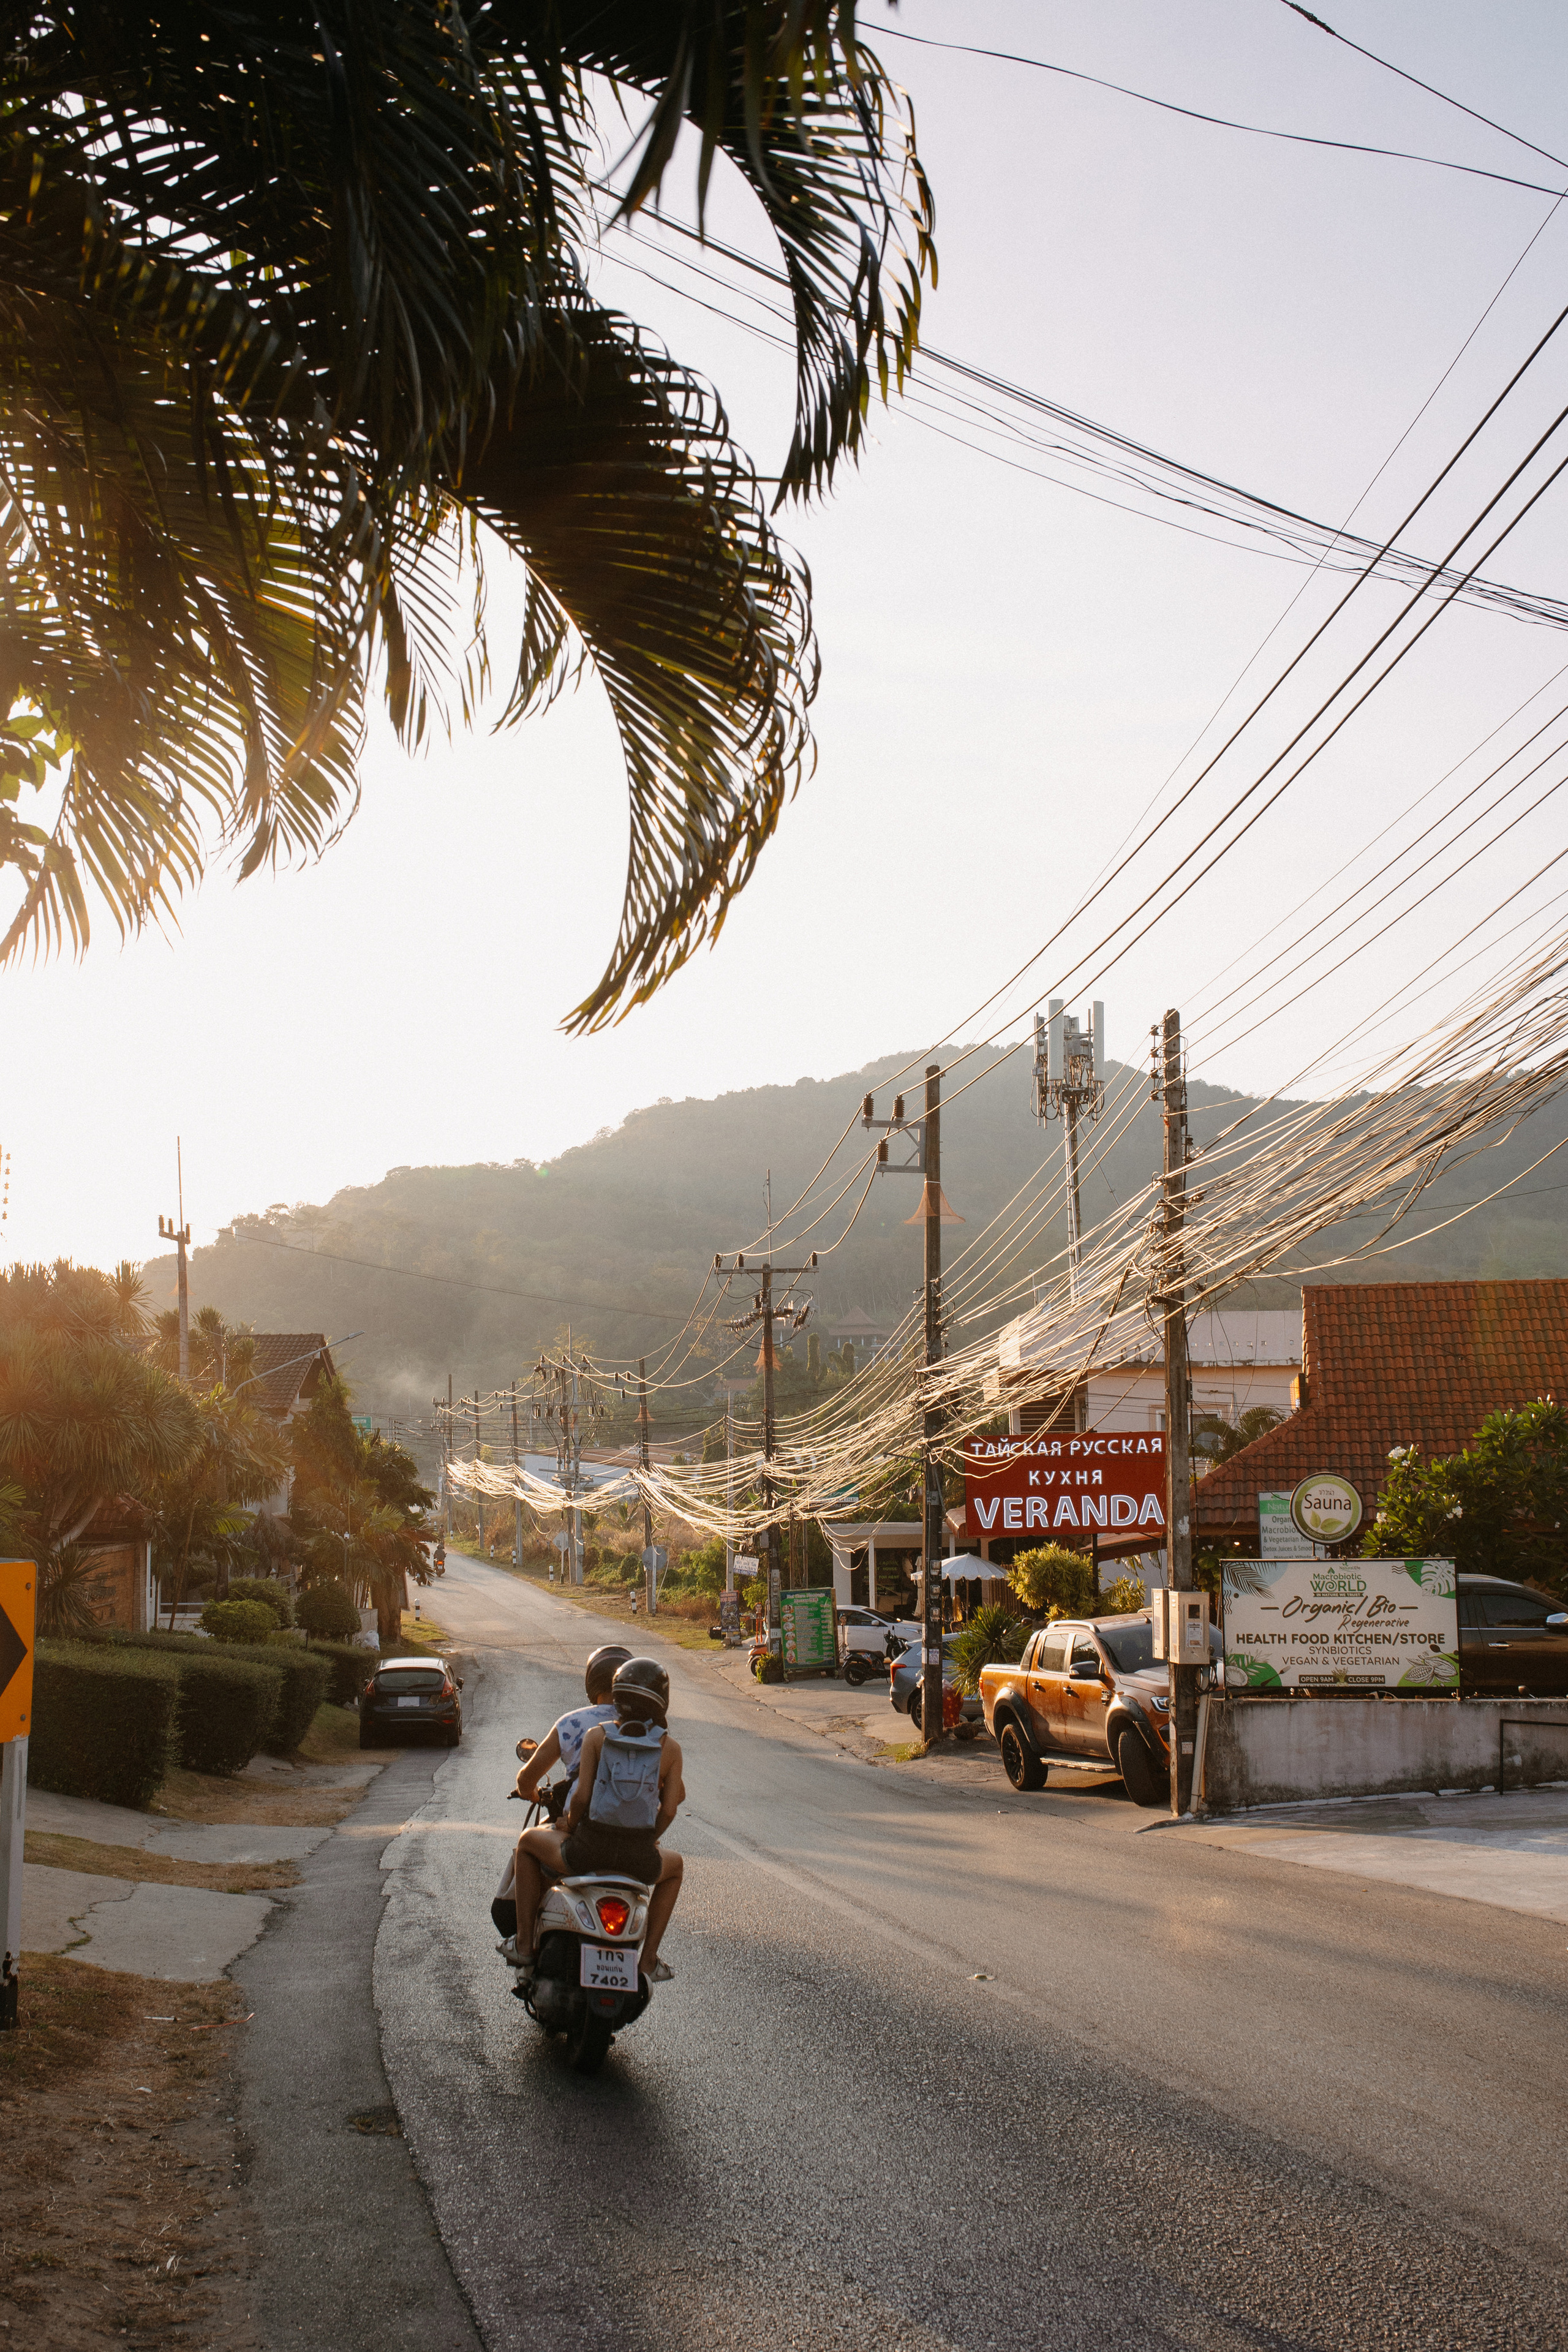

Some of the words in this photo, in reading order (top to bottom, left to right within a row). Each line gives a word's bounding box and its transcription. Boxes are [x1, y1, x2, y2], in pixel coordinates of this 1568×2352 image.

[971, 1438, 1061, 1457] ТАЙСКАЯ
[1070, 1438, 1163, 1456] РУССКАЯ
[1028, 1469, 1103, 1485] КУХНЯ
[1304, 1494, 1351, 1510] Sauna
[974, 1493, 1165, 1529] VERANDA
[1272, 1516, 1291, 1525] Organ
[1306, 1528, 1324, 1539] Holistic
[1325, 1529, 1346, 1539] Harmony
[1310, 1580, 1367, 1592] WORLD
[1366, 1595, 1396, 1618] Bio
[1338, 1614, 1409, 1633] Regenerative
[1236, 1633, 1287, 1644] HEALTH
[1292, 1633, 1330, 1644] FOOD
[1334, 1632, 1446, 1646] KITCHEN/STORE
[1309, 1646, 1372, 1654] SYNBIOTICS
[1282, 1656, 1319, 1665] VEGAN
[1322, 1656, 1329, 1665] &
[1333, 1656, 1400, 1665] VEGETARIAN
[597, 1950, 625, 1962] 1กจ
[590, 1973, 628, 1988] 7402
